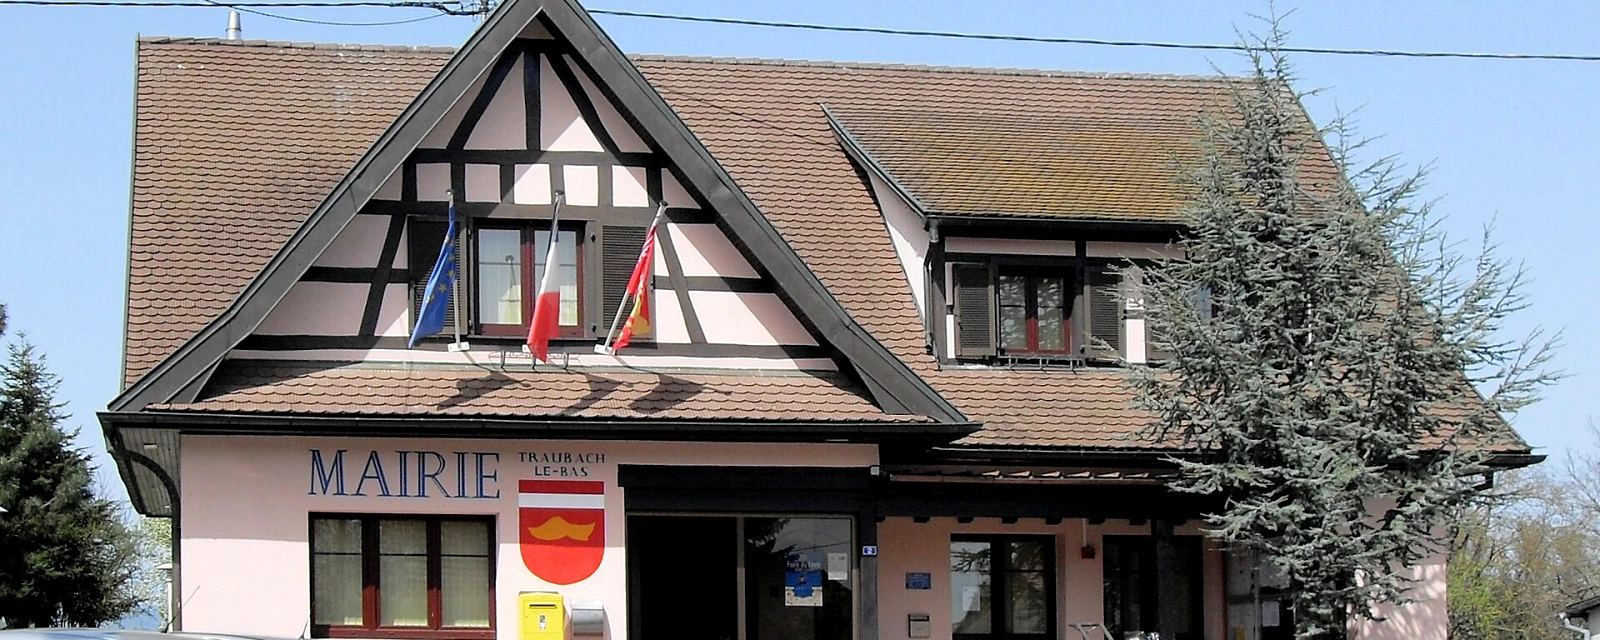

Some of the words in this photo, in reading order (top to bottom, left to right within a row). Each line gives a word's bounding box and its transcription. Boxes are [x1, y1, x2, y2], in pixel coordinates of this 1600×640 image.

[518, 451, 605, 463] TRAUBACH
[307, 449, 501, 499] MAIRIE
[534, 466, 588, 477] LE-BAS
